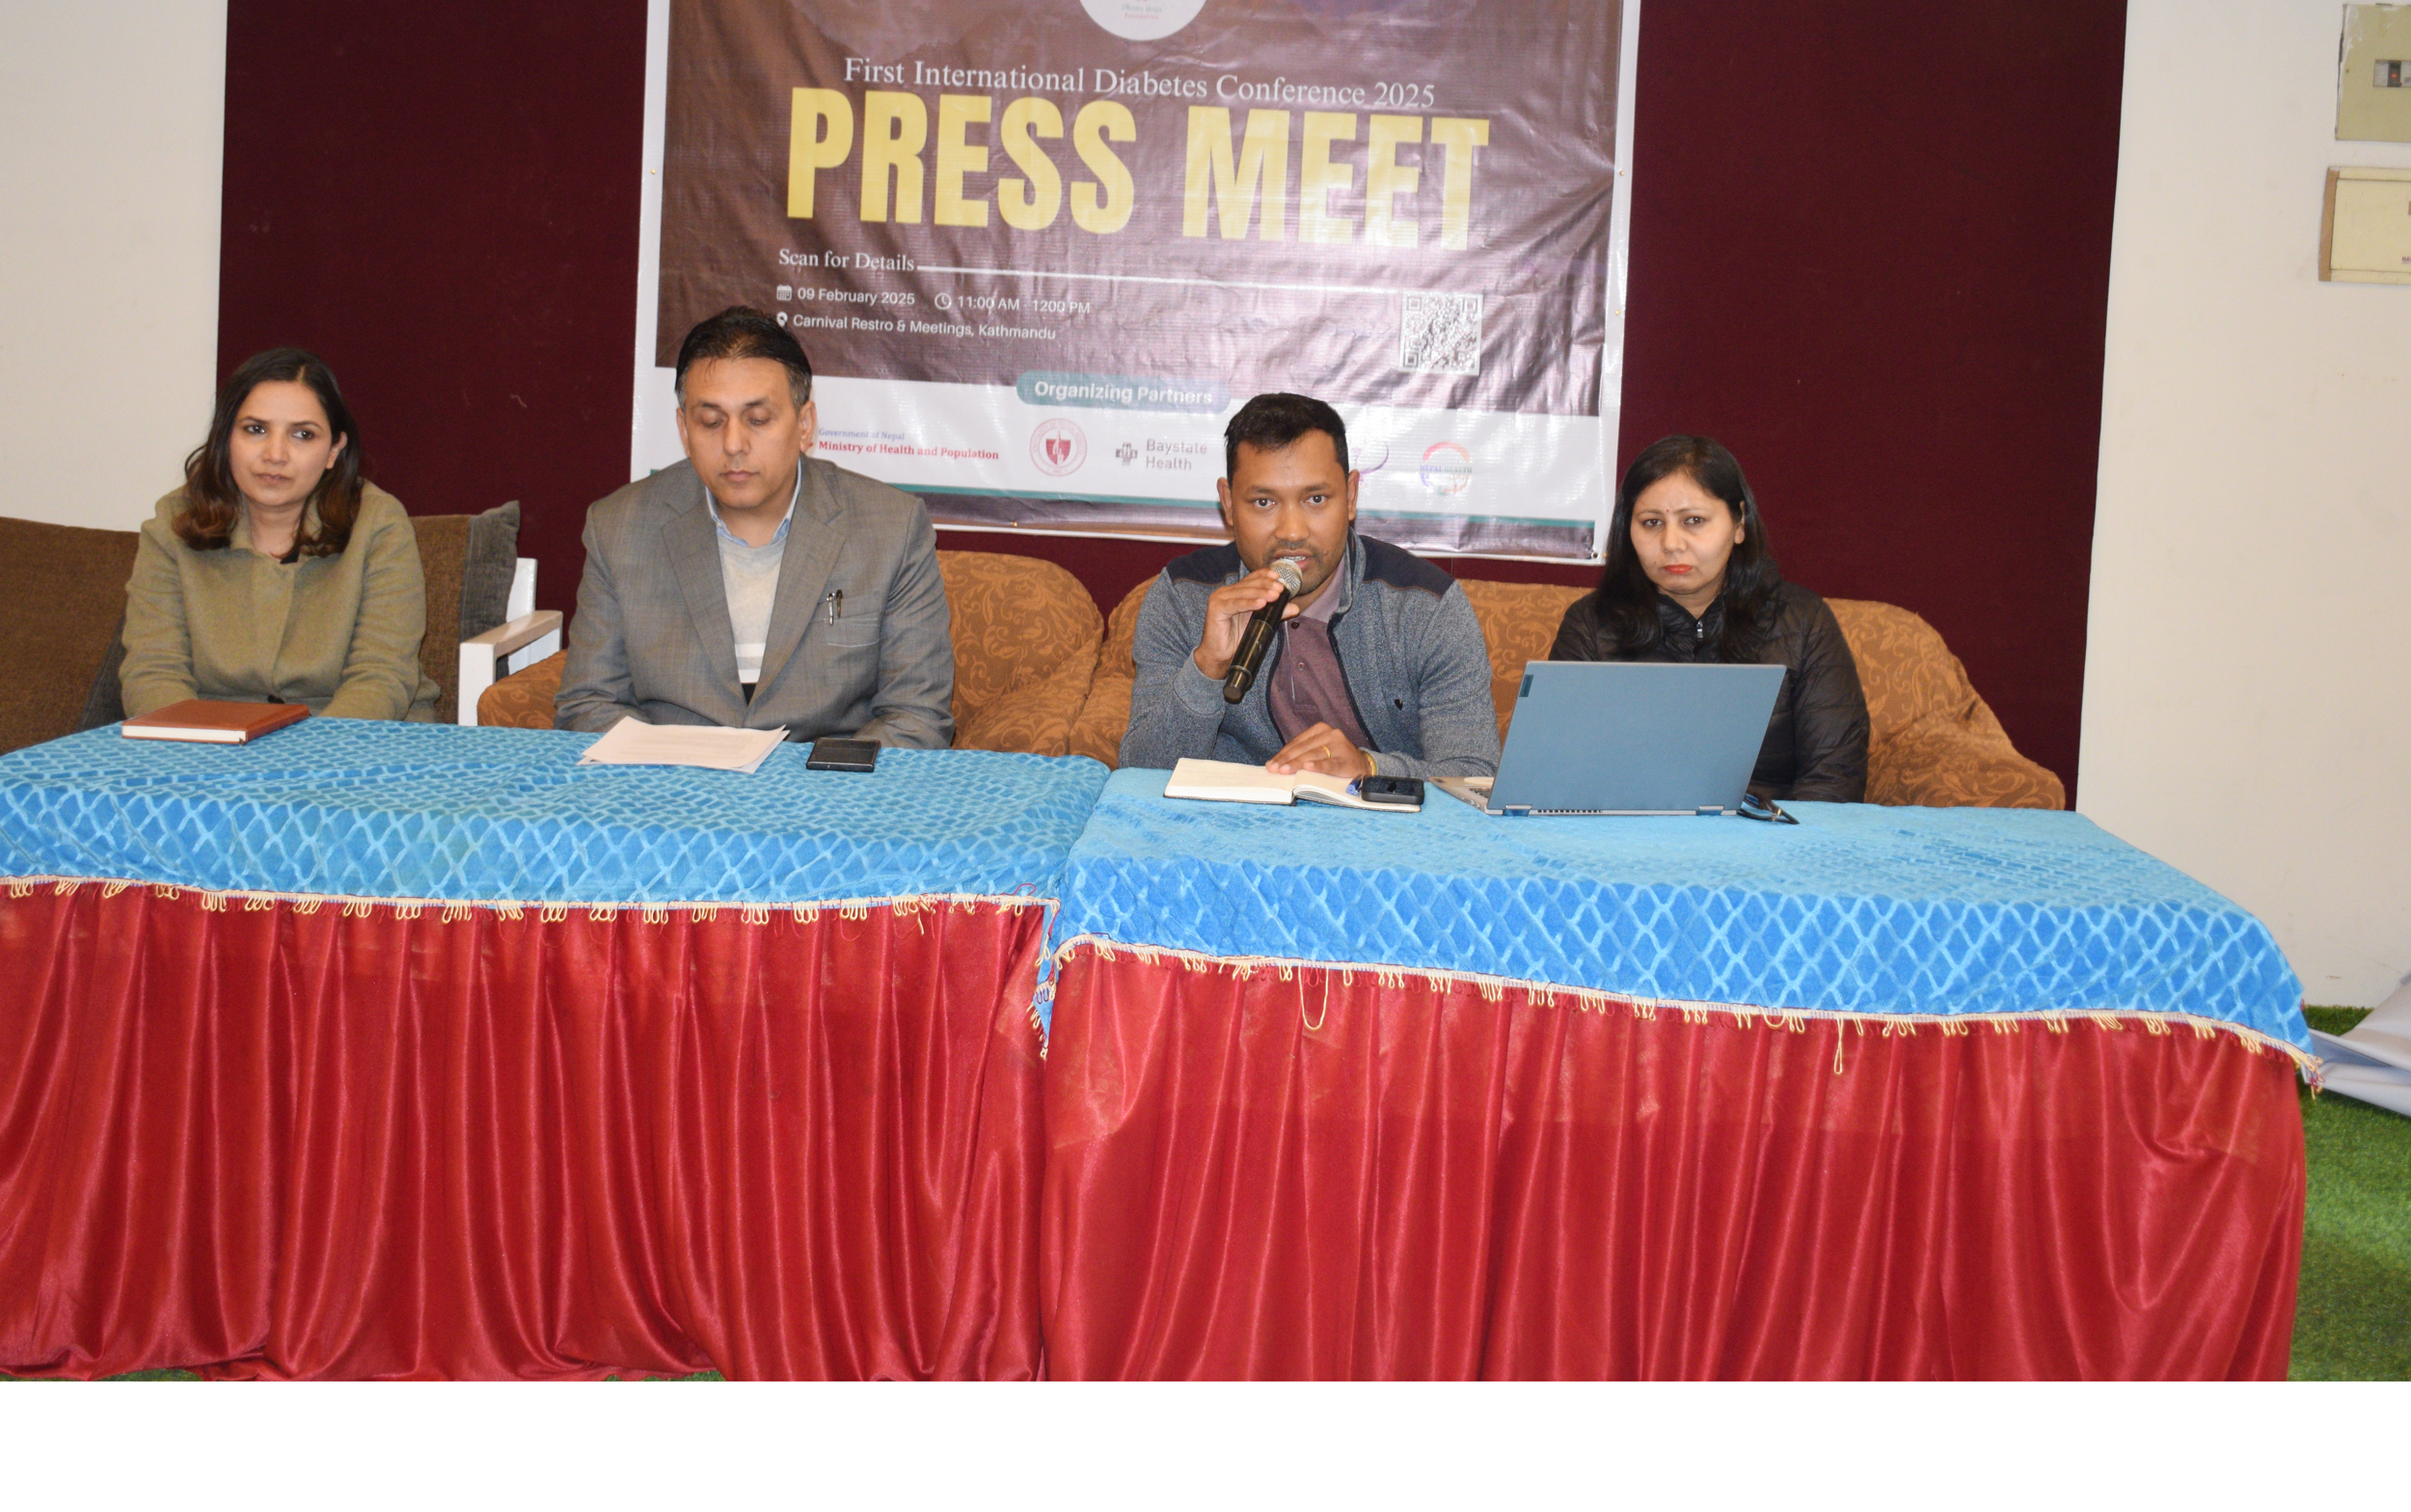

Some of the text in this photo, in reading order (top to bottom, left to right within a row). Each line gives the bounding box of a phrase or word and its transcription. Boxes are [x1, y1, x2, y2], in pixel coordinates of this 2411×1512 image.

[844, 57, 1435, 108] First International Diabetes Conference 2025
[787, 87, 1490, 251] PRESS MEET
[779, 248, 914, 271] Scan for Details
[798, 287, 915, 307] 09 February 2025
[958, 296, 995, 310] 11:00
[997, 298, 1020, 310] AM
[1033, 300, 1066, 312] 1200
[1069, 302, 1091, 314] PM
[793, 313, 1056, 339] Carnival Restro & Meetings, Kathmandu
[1034, 380, 1213, 405] Organizing Partners
[820, 428, 869, 439] Government
[881, 431, 906, 442] Nepal
[819, 441, 999, 460] Ministry of Health and Population
[1147, 438, 1208, 455] Baystate
[1146, 456, 1192, 471] Health
[1420, 464, 1473, 474] NEPAL HEALTH
